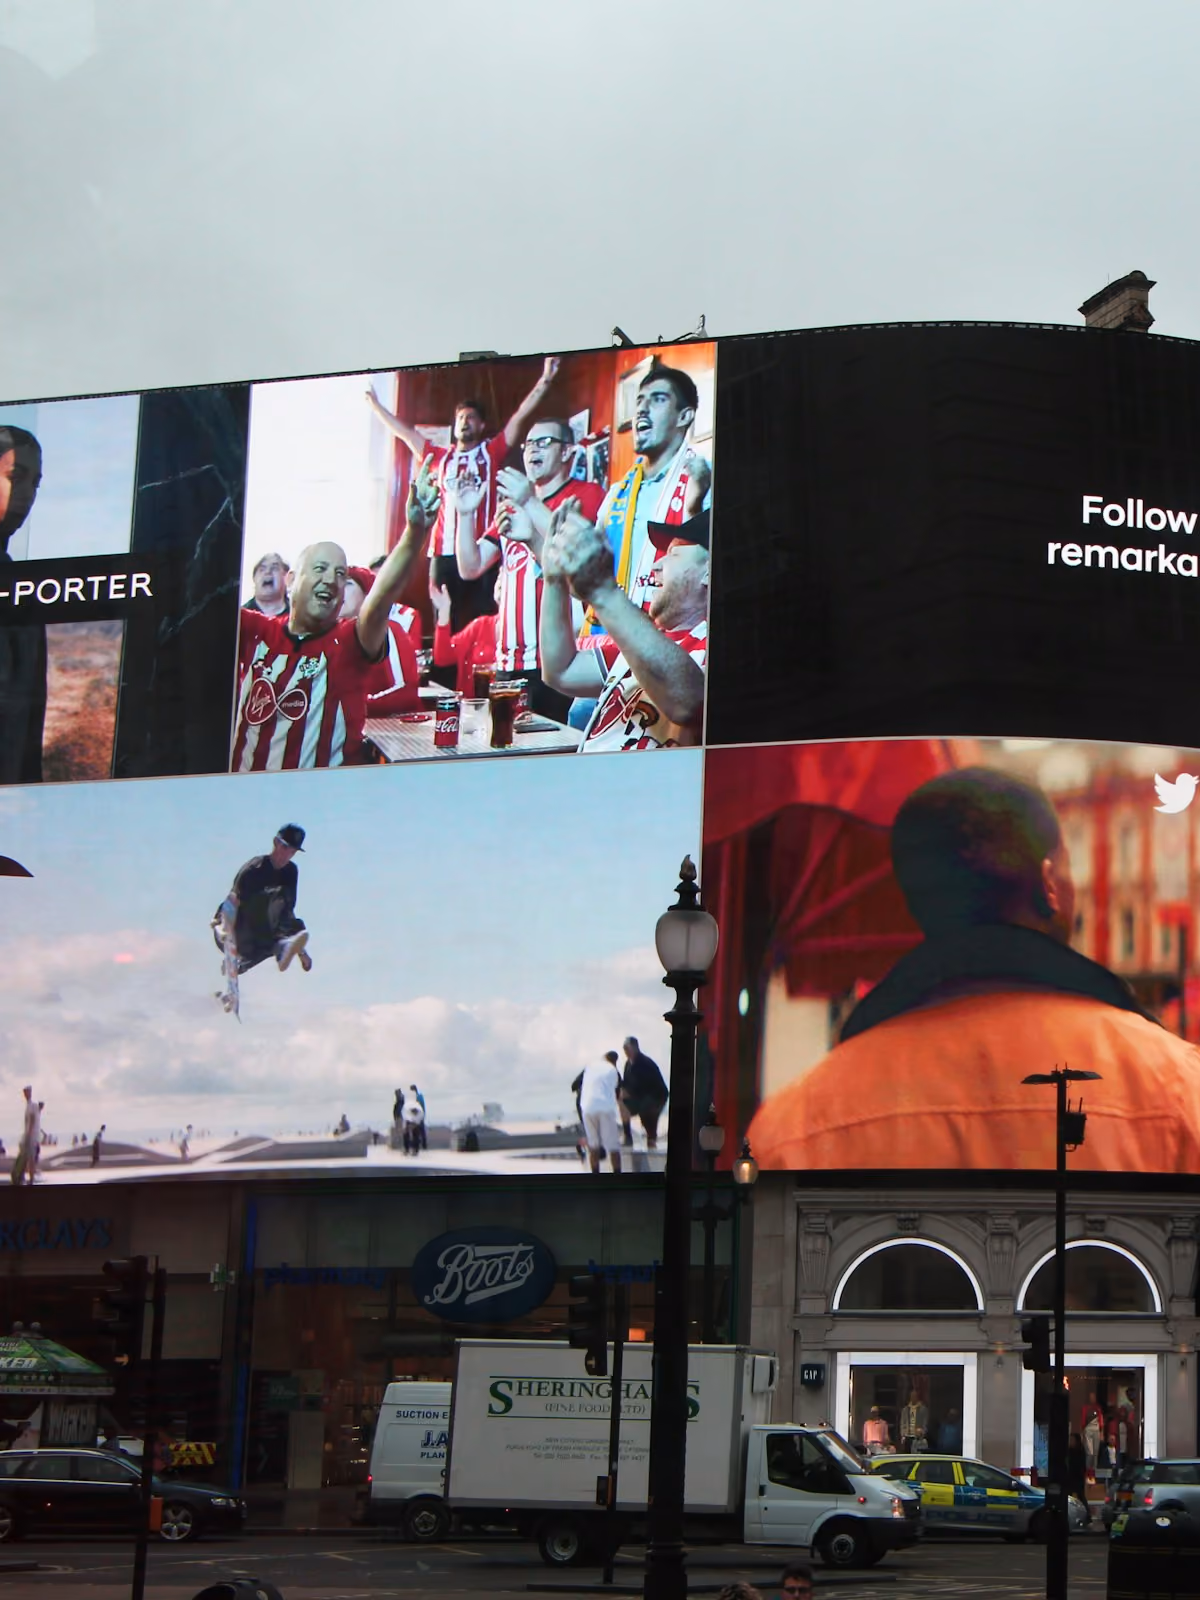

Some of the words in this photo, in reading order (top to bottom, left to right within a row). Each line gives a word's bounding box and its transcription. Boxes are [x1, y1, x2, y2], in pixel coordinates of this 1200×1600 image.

[1082, 495, 1198, 534] Follow
[424, 1243, 535, 1305] Boots
[803, 1369, 818, 1380] GAP
[488, 1380, 700, 1419] SHERINGHAS
[396, 1410, 439, 1419] SUCTION
[578, 1403, 611, 1413] FOOD
[421, 1430, 450, 1449] J.A
[926, 1510, 1017, 1524] POLICE
